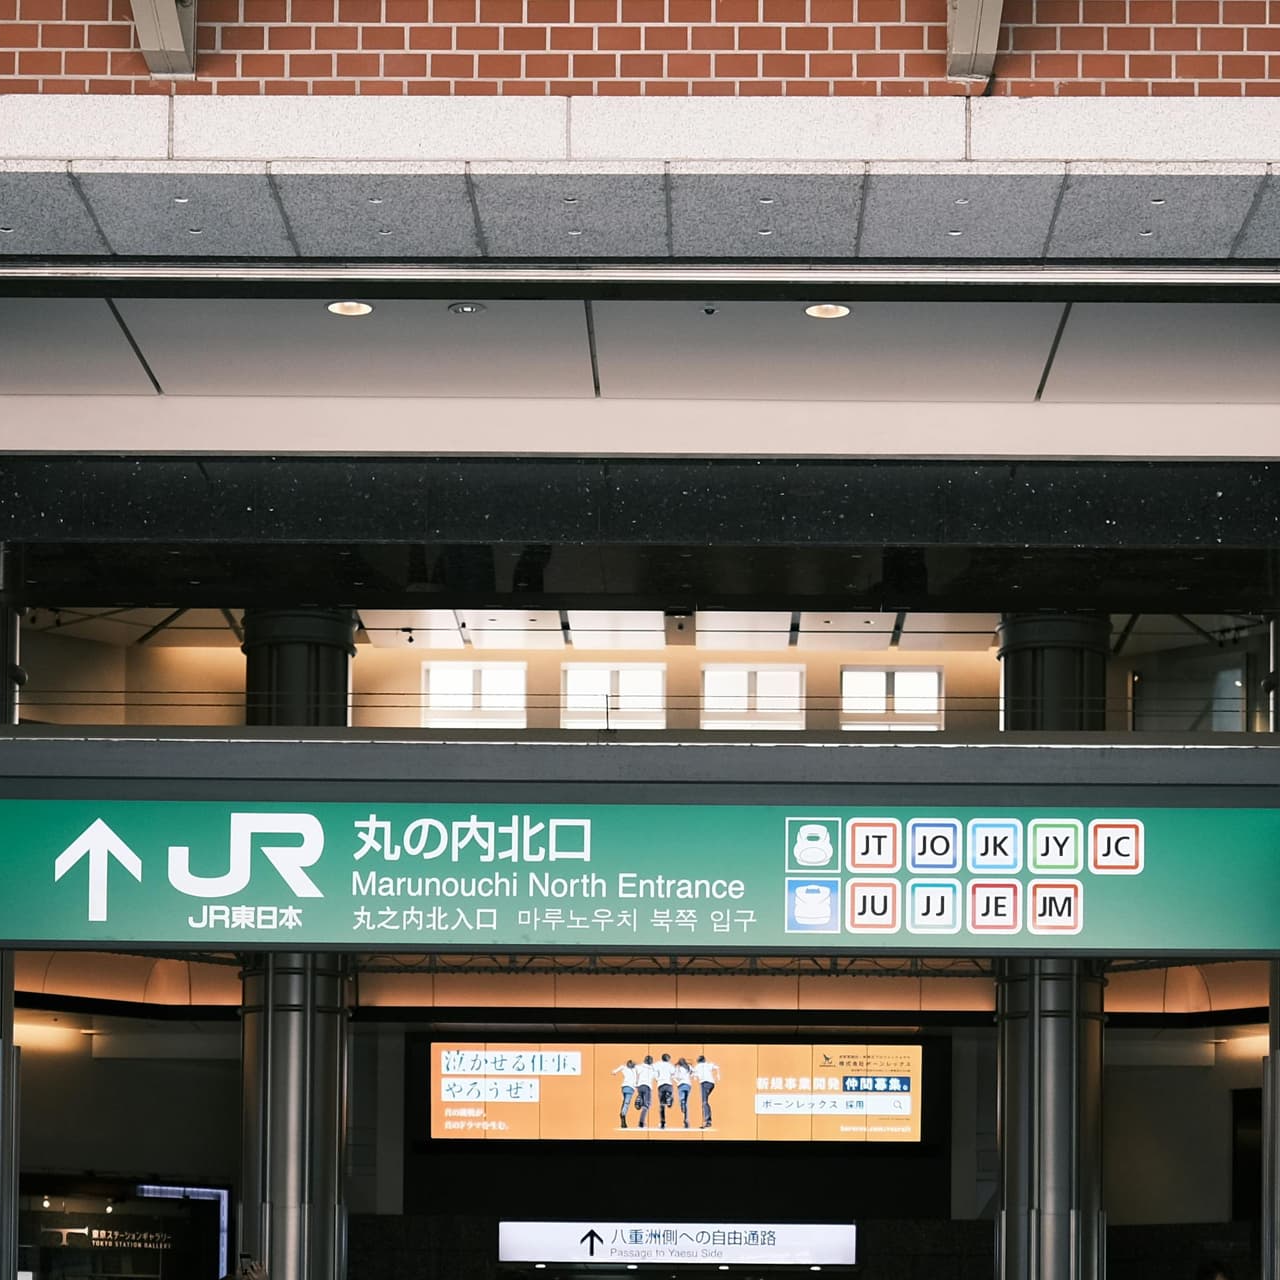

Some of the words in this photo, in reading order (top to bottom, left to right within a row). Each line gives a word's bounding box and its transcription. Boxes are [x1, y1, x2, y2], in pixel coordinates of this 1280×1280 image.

[354, 814, 591, 862] 丸の内北口
[862, 836, 887, 855] JT
[918, 836, 949, 855] JO
[981, 836, 1008, 856] JK
[1041, 837, 1069, 856] JY
[1101, 836, 1130, 856] JC
[168, 813, 325, 898] JR
[353, 871, 517, 897] Marunouchi
[529, 873, 606, 897] North
[619, 873, 744, 899] Entrance
[189, 905, 302, 929] JR東日本
[353, 906, 496, 930] 丸之内北入口
[858, 896, 887, 915] JU
[922, 896, 944, 916] JJ
[981, 896, 1007, 916] JE
[1038, 896, 1072, 916] JM
[519, 908, 636, 932] 마루노우치
[651, 909, 697, 932] 북쪽
[711, 910, 756, 932] 입구
[612, 1229, 776, 1245] 八重洲側への自由通路
[610, 1248, 653, 1258] Passage
[655, 1248, 666, 1257] to
[669, 1248, 698, 1258] Yaesu
[701, 1249, 723, 1258] Side
